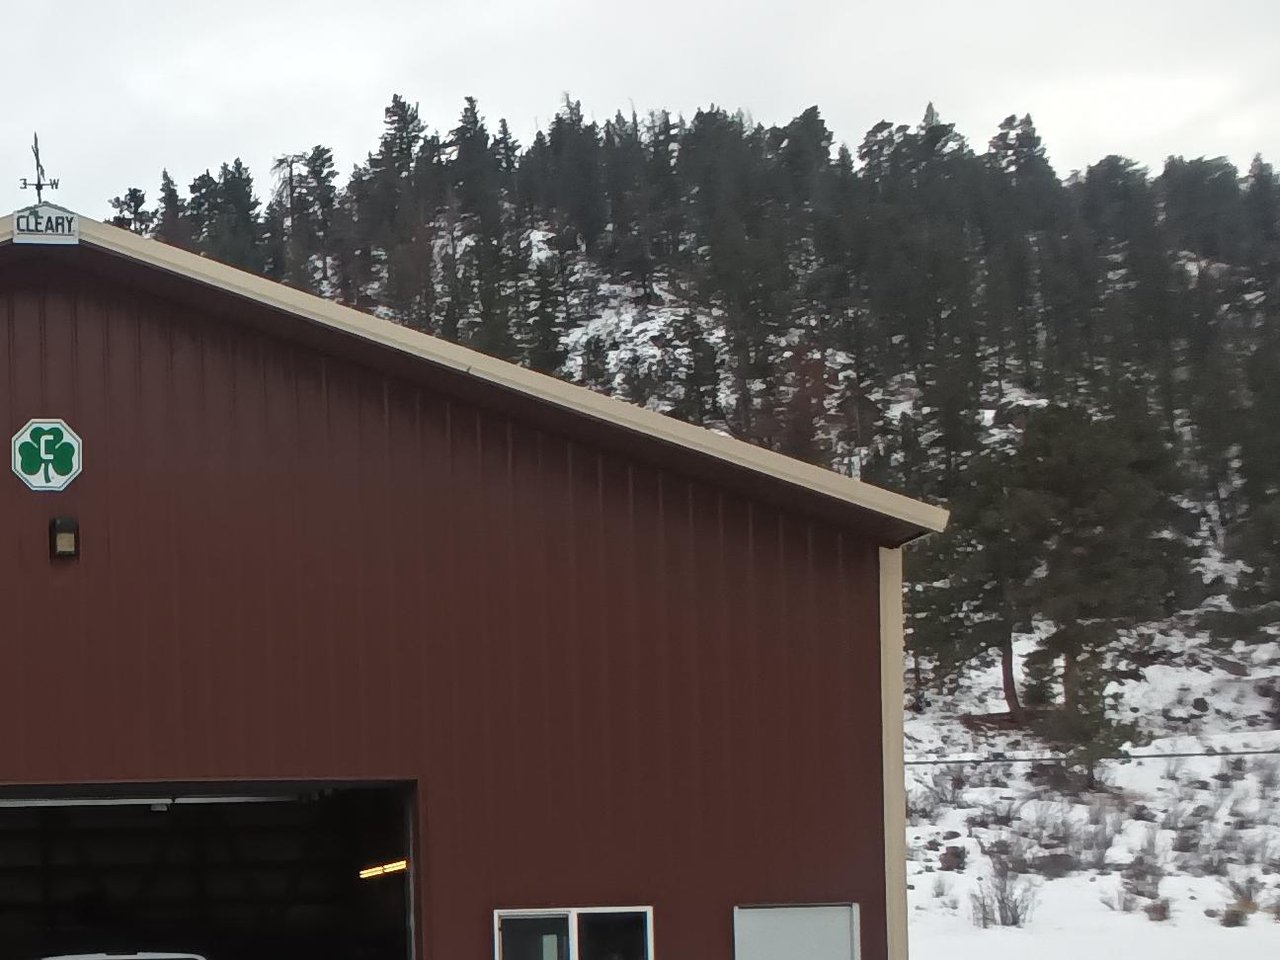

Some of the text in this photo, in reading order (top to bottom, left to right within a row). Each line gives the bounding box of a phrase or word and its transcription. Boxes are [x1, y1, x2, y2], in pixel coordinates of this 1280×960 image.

[49, 178, 60, 190] W
[16, 215, 75, 234] CLEARY
[40, 434, 54, 460] C
